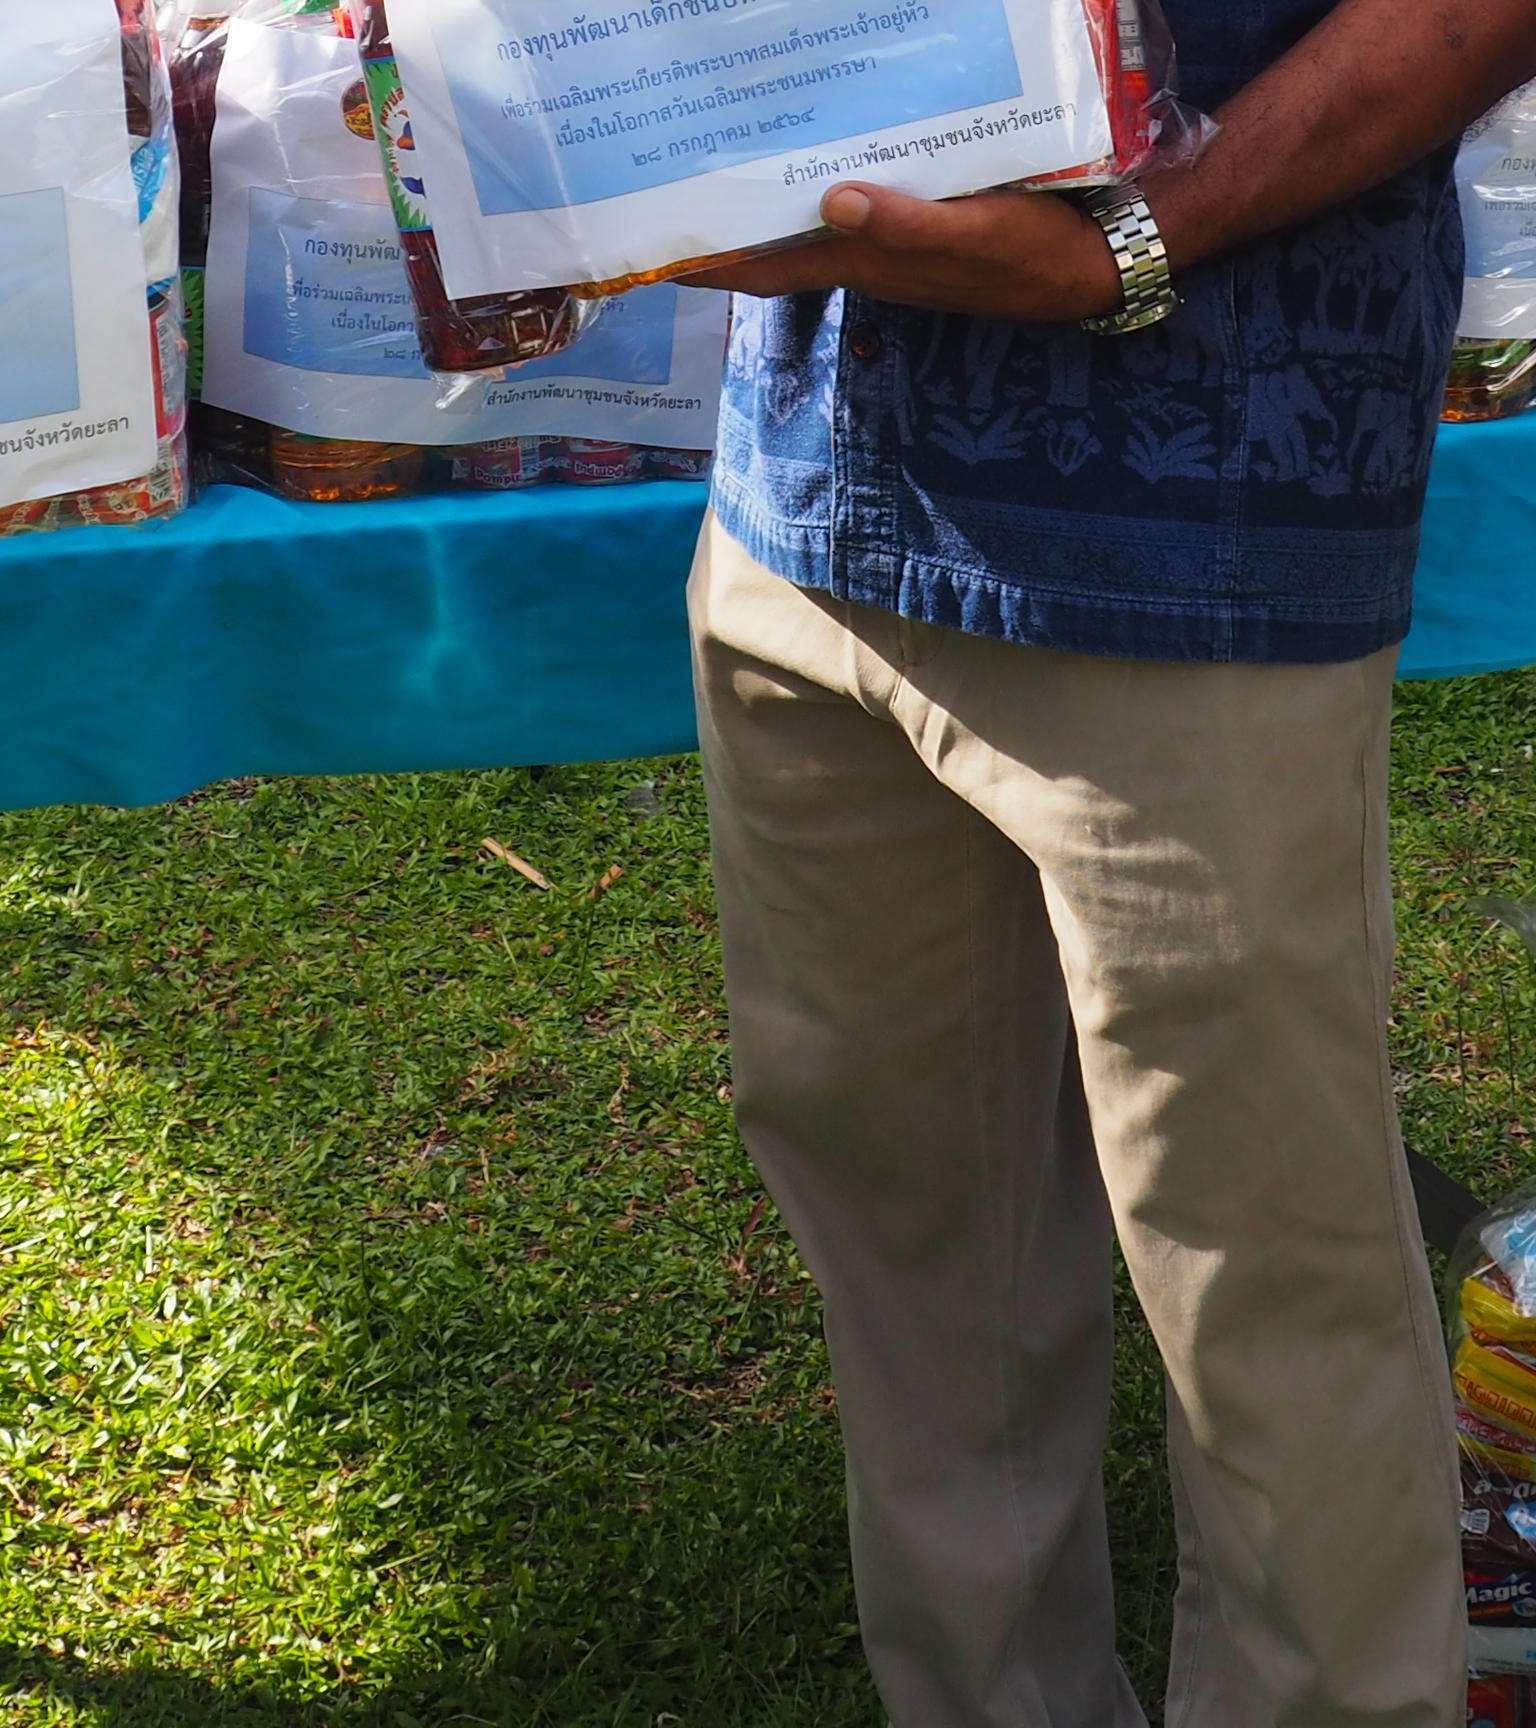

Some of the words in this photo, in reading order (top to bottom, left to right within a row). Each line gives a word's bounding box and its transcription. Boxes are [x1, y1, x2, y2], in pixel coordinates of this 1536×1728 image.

[555, 54, 878, 150] เนื่องในโอกาสวันเฉลิมพระชนมพรรษา
[631, 144, 663, 170] ๒๘
[667, 121, 753, 165] กรกฎาคม
[757, 105, 816, 141] ๒๕๖๔
[782, 101, 1077, 188] สำนักงานพัฒนาชุมชนจังหวัดยะลา
[486, 384, 702, 412] สำนักงานพัฒนาชุมชนจังหวัดยะลา
